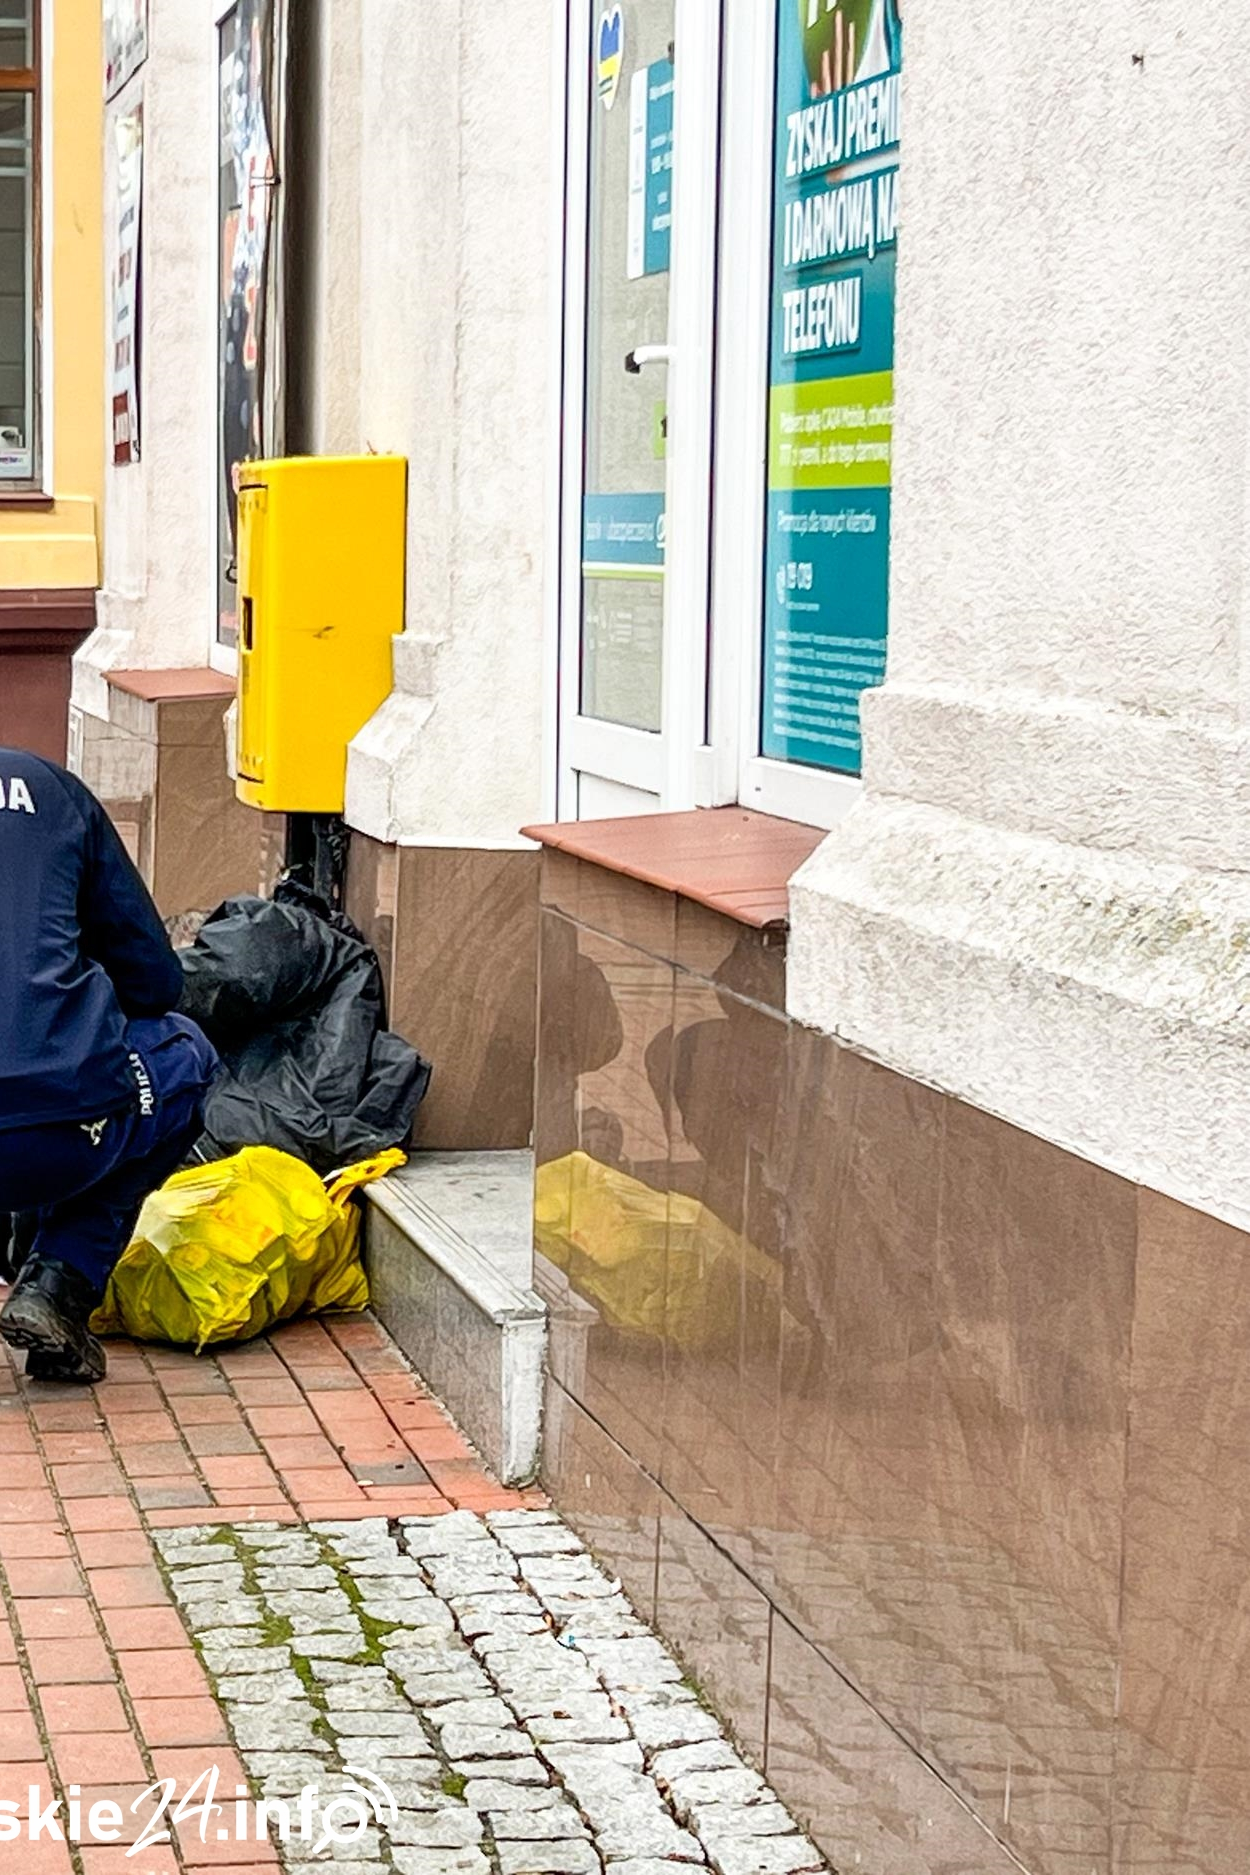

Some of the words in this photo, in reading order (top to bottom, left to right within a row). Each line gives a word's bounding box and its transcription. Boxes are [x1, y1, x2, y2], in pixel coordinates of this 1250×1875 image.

[785, 94, 844, 178] ZYSKAJ
[792, 178, 875, 260] DARMOWĄ
[782, 276, 861, 354] TELEFONU
